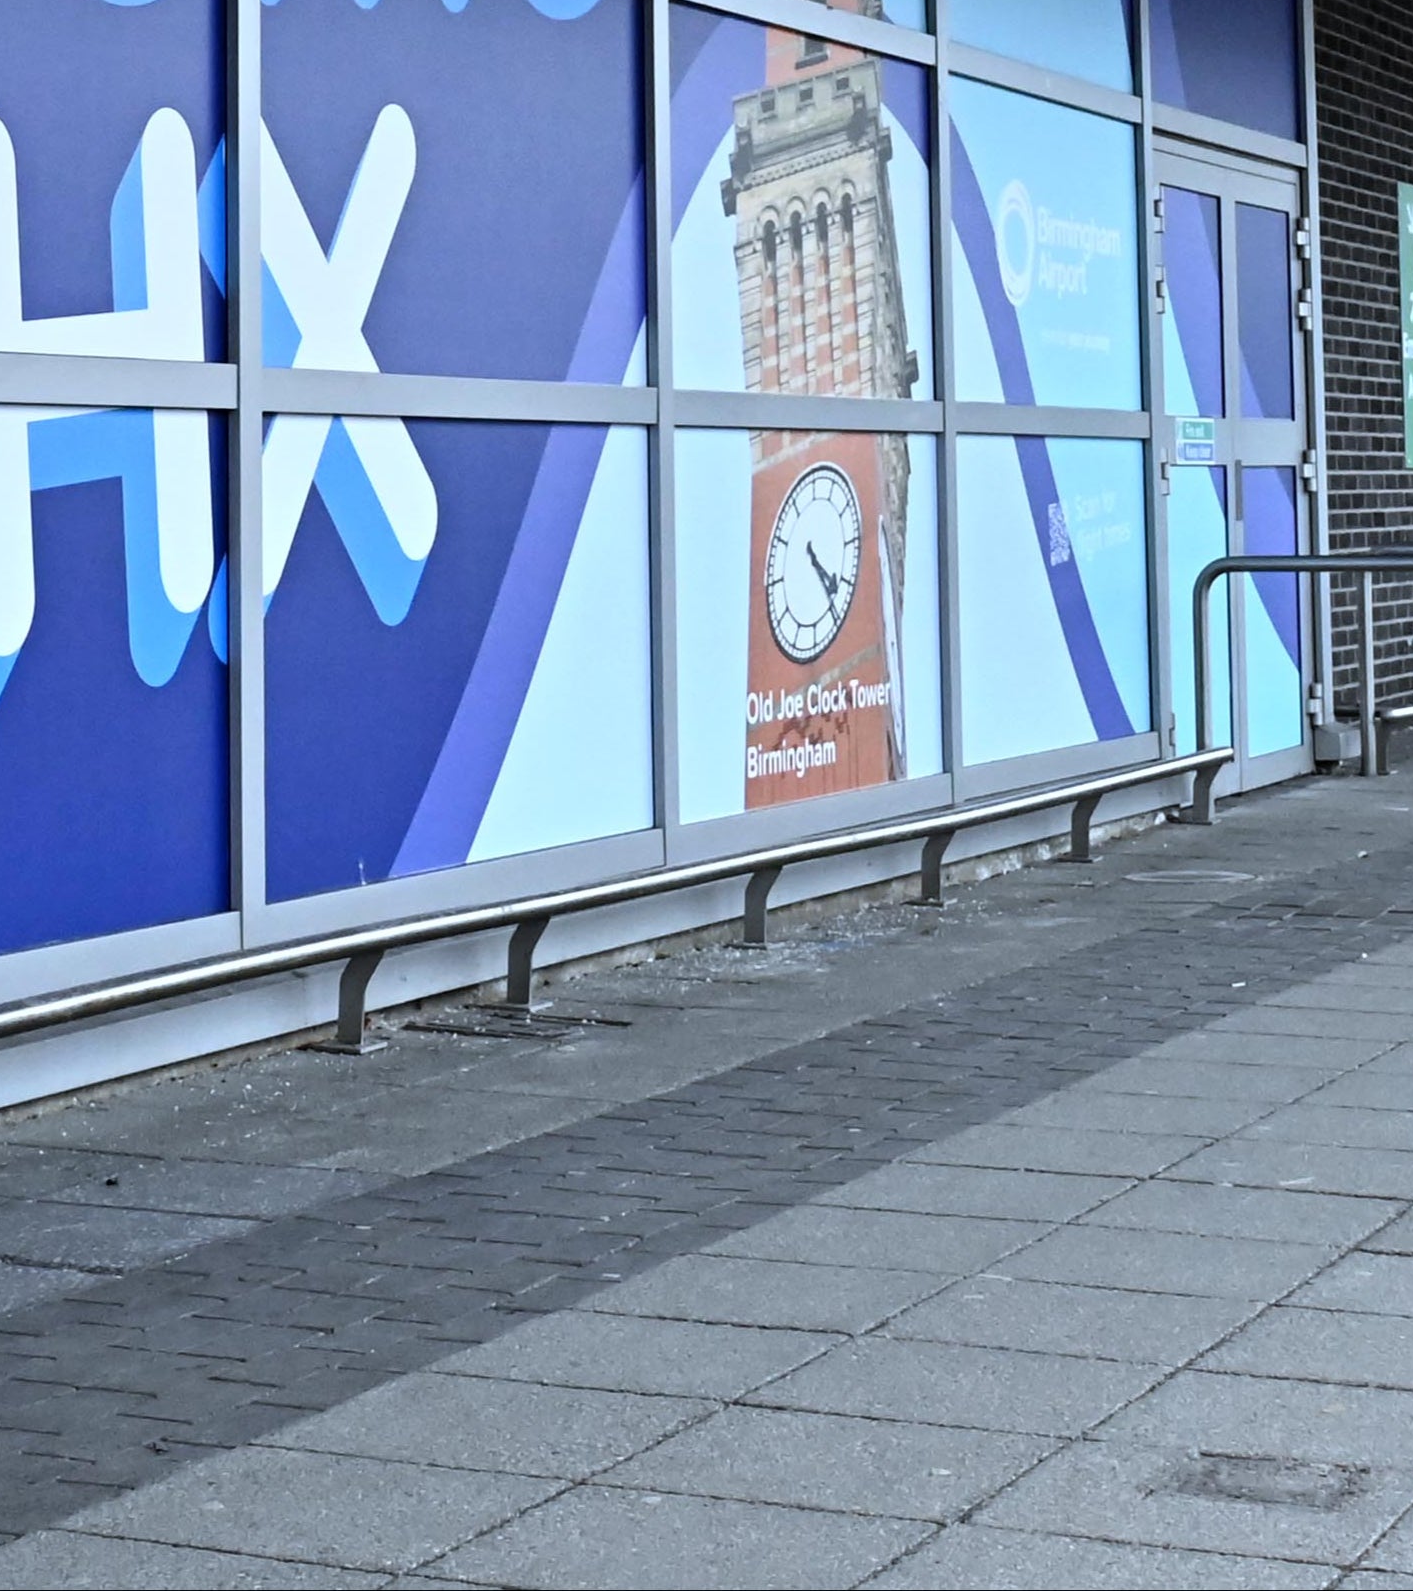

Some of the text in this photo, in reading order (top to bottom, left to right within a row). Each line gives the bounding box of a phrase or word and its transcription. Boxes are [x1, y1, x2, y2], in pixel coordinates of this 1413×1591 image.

[1038, 206, 1121, 262] Birmingham
[1039, 251, 1087, 299] Airport
[746, 679, 891, 724] Old Joe Clock Tower
[747, 738, 836, 778] Birmingham
